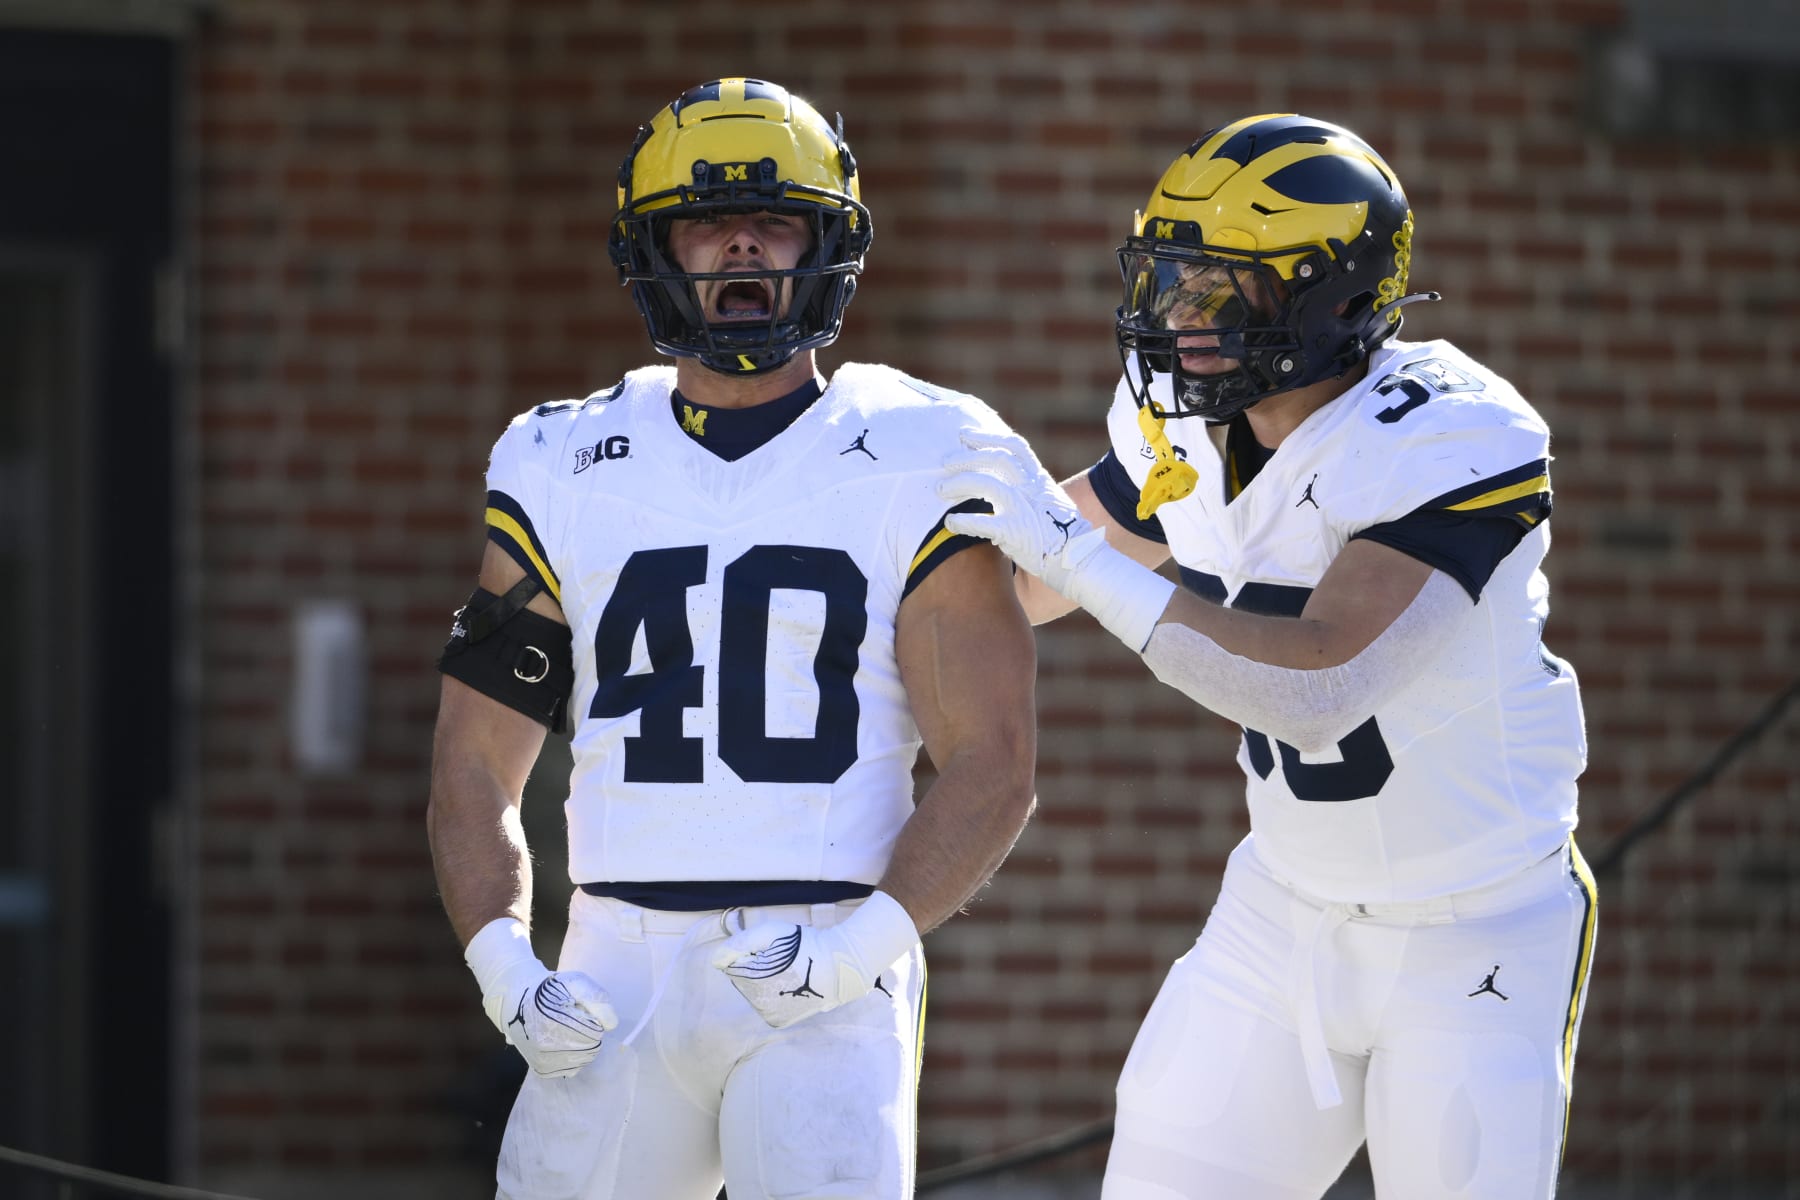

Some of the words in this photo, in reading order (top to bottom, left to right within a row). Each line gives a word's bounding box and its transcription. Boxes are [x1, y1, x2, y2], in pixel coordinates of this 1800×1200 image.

[724, 164, 748, 181] M
[1154, 220, 1176, 240] M
[682, 404, 708, 437] M
[588, 544, 868, 783] 40
